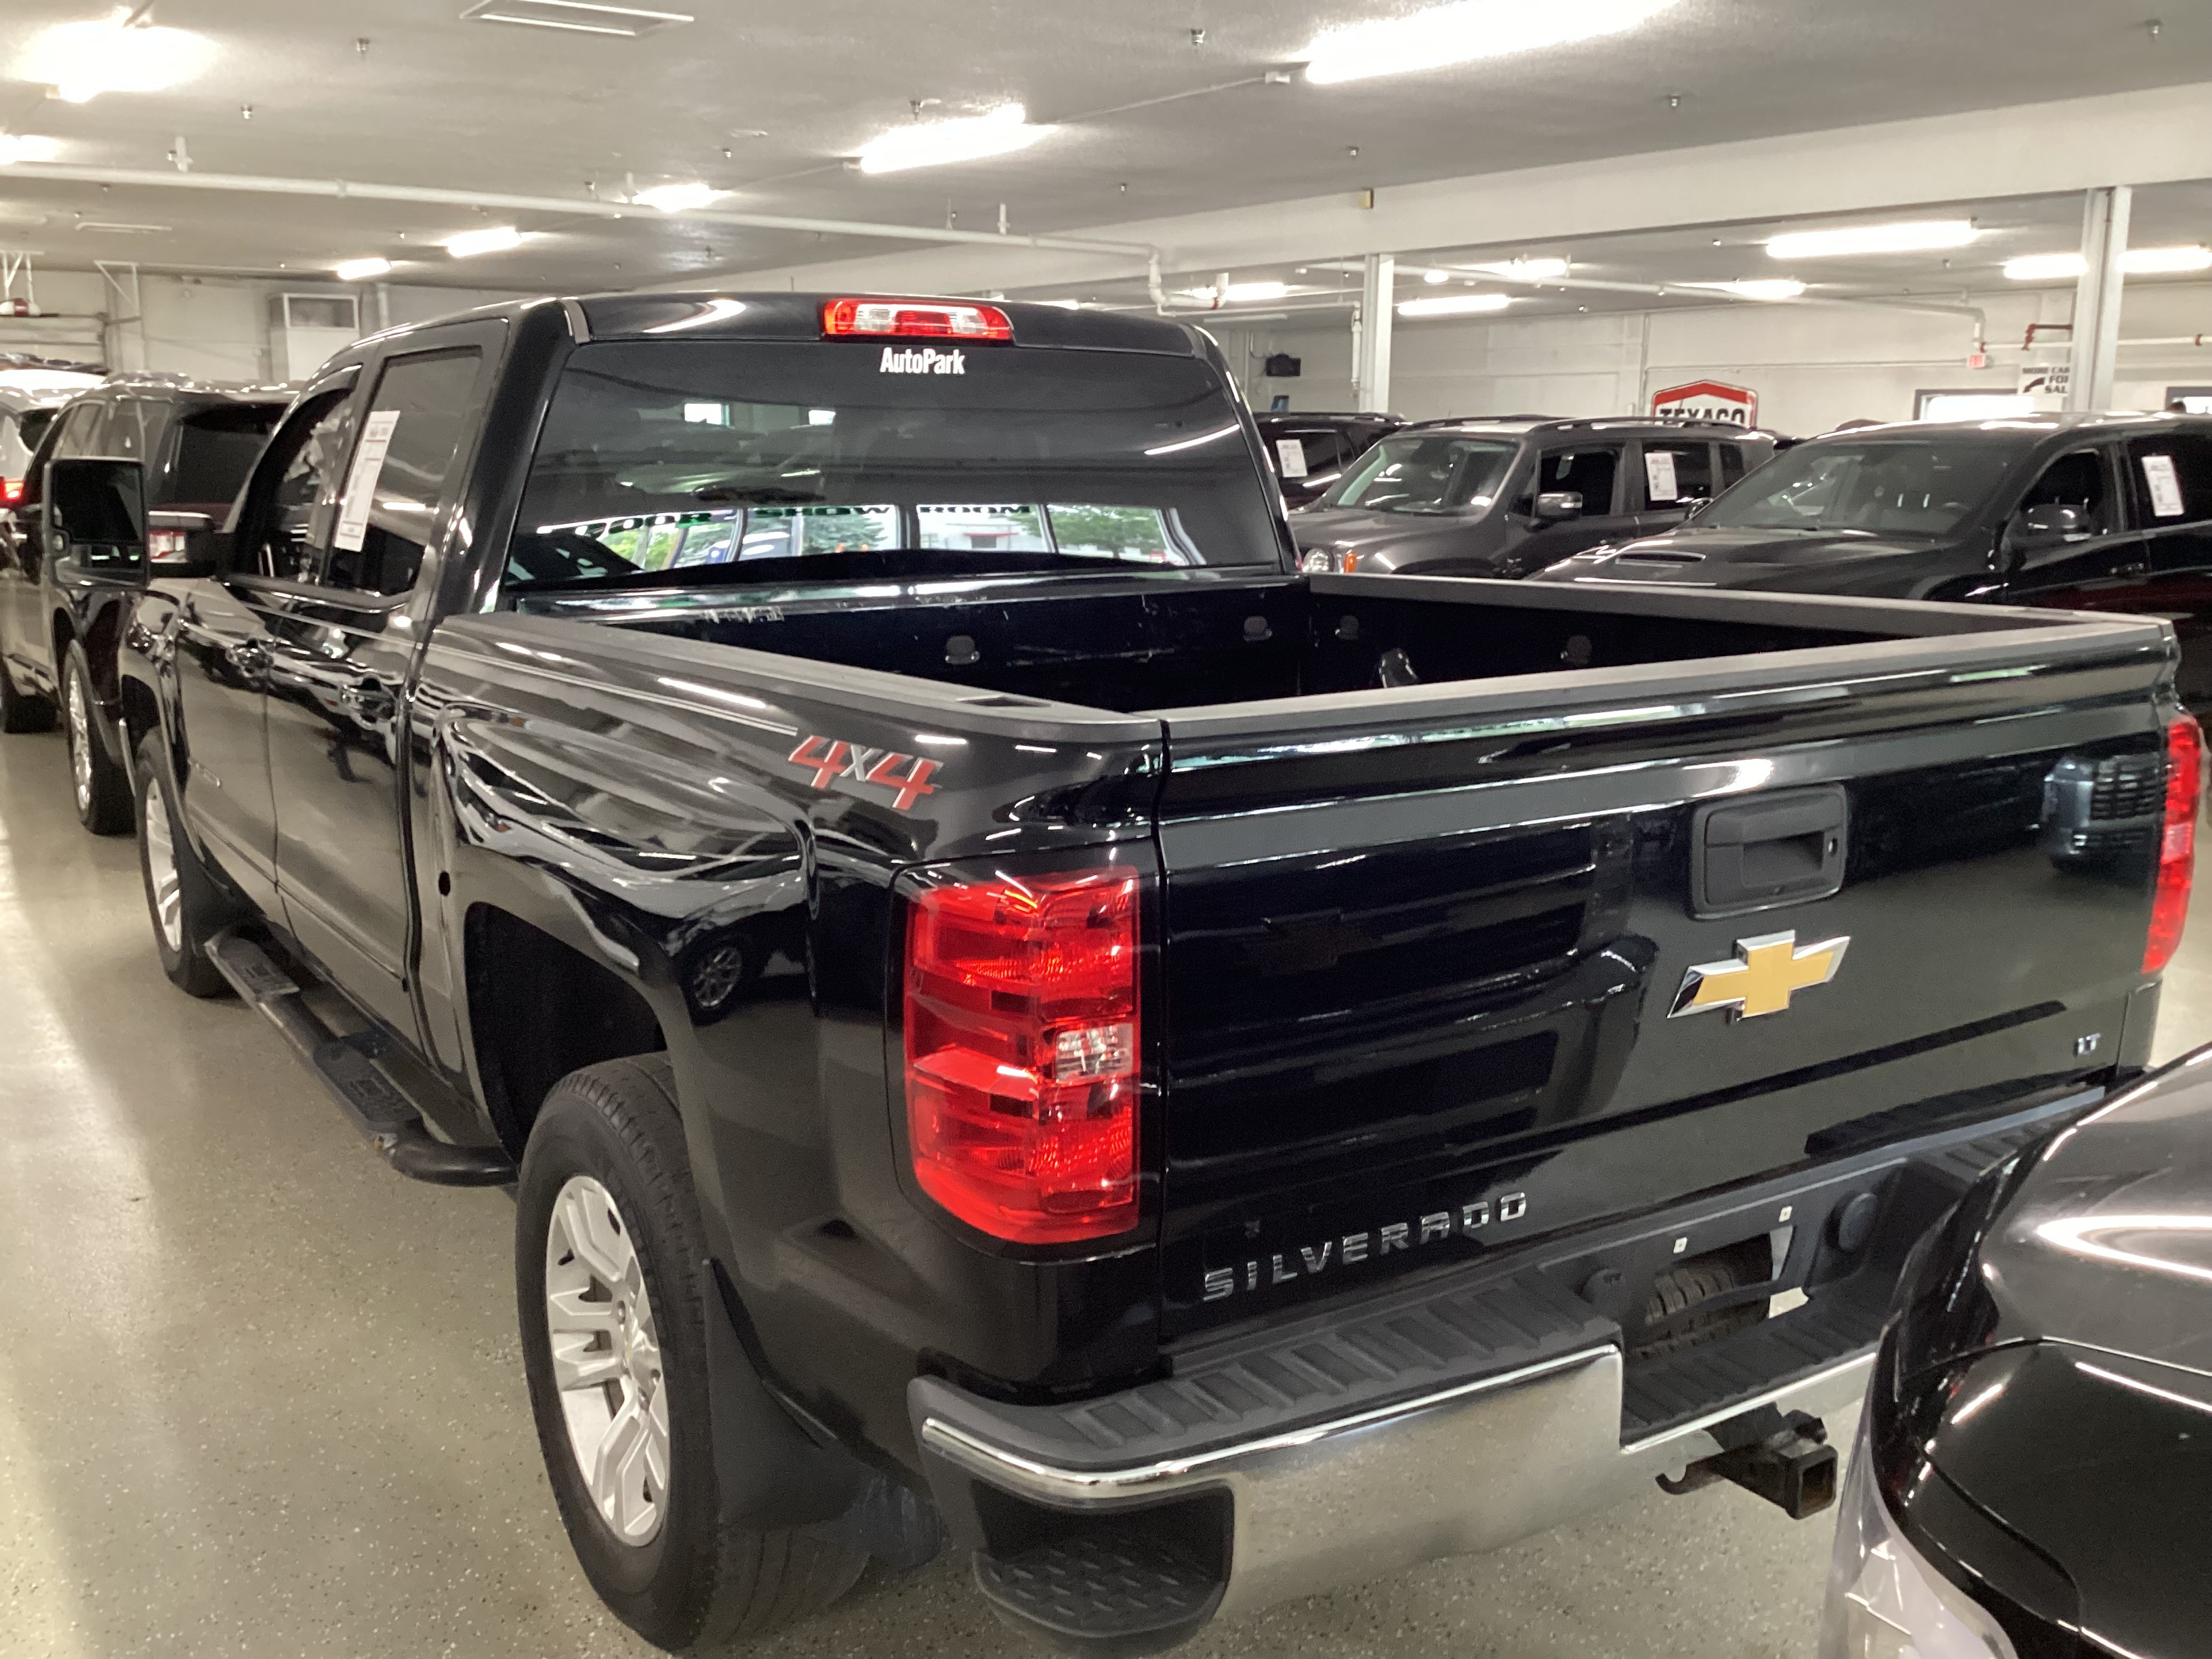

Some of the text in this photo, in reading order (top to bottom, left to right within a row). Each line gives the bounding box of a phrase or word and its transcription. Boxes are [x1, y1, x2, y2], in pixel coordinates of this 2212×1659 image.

[880, 346, 965, 374] AutoPark
[2075, 1033, 2101, 1056] LT
[1204, 1191, 1526, 1301] SILVERADO
